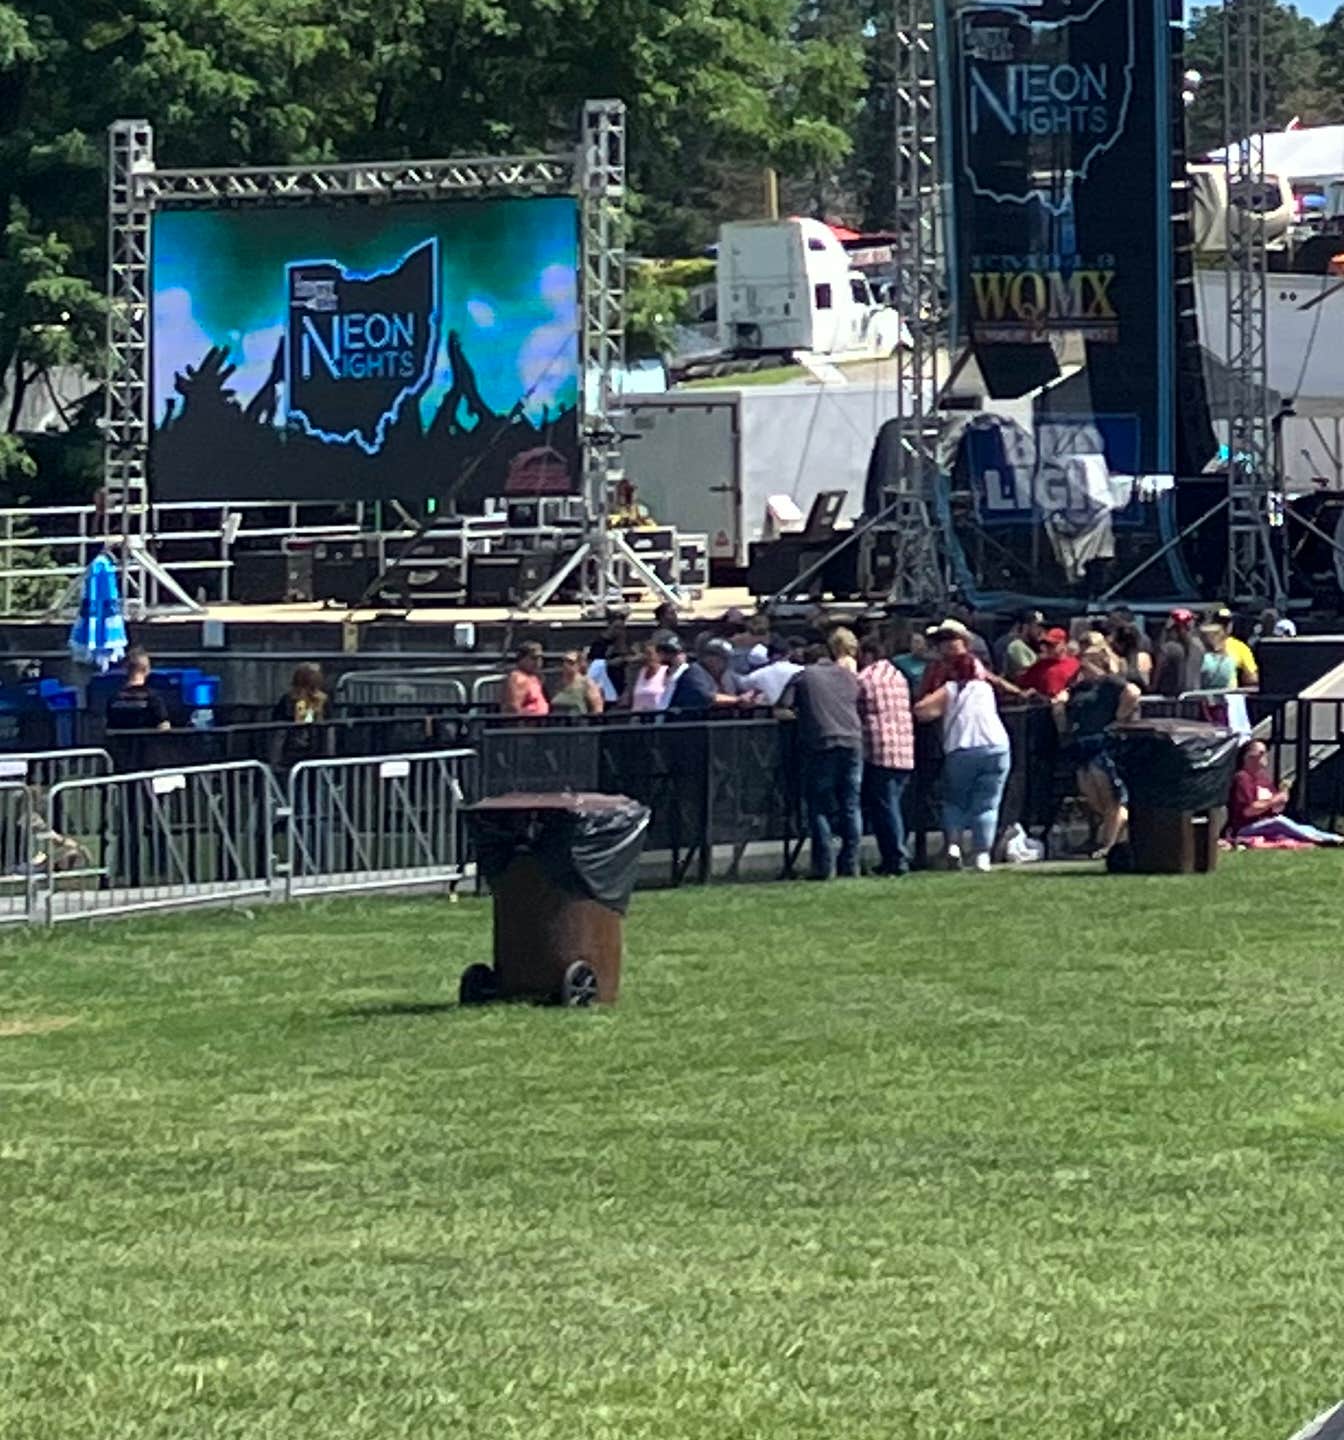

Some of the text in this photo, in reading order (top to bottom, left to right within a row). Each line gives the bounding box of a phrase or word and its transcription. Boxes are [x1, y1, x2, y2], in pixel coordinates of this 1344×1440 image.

[970, 63, 1106, 135] NEON
[970, 270, 1118, 322] WQMX
[302, 312, 415, 380] NEON
